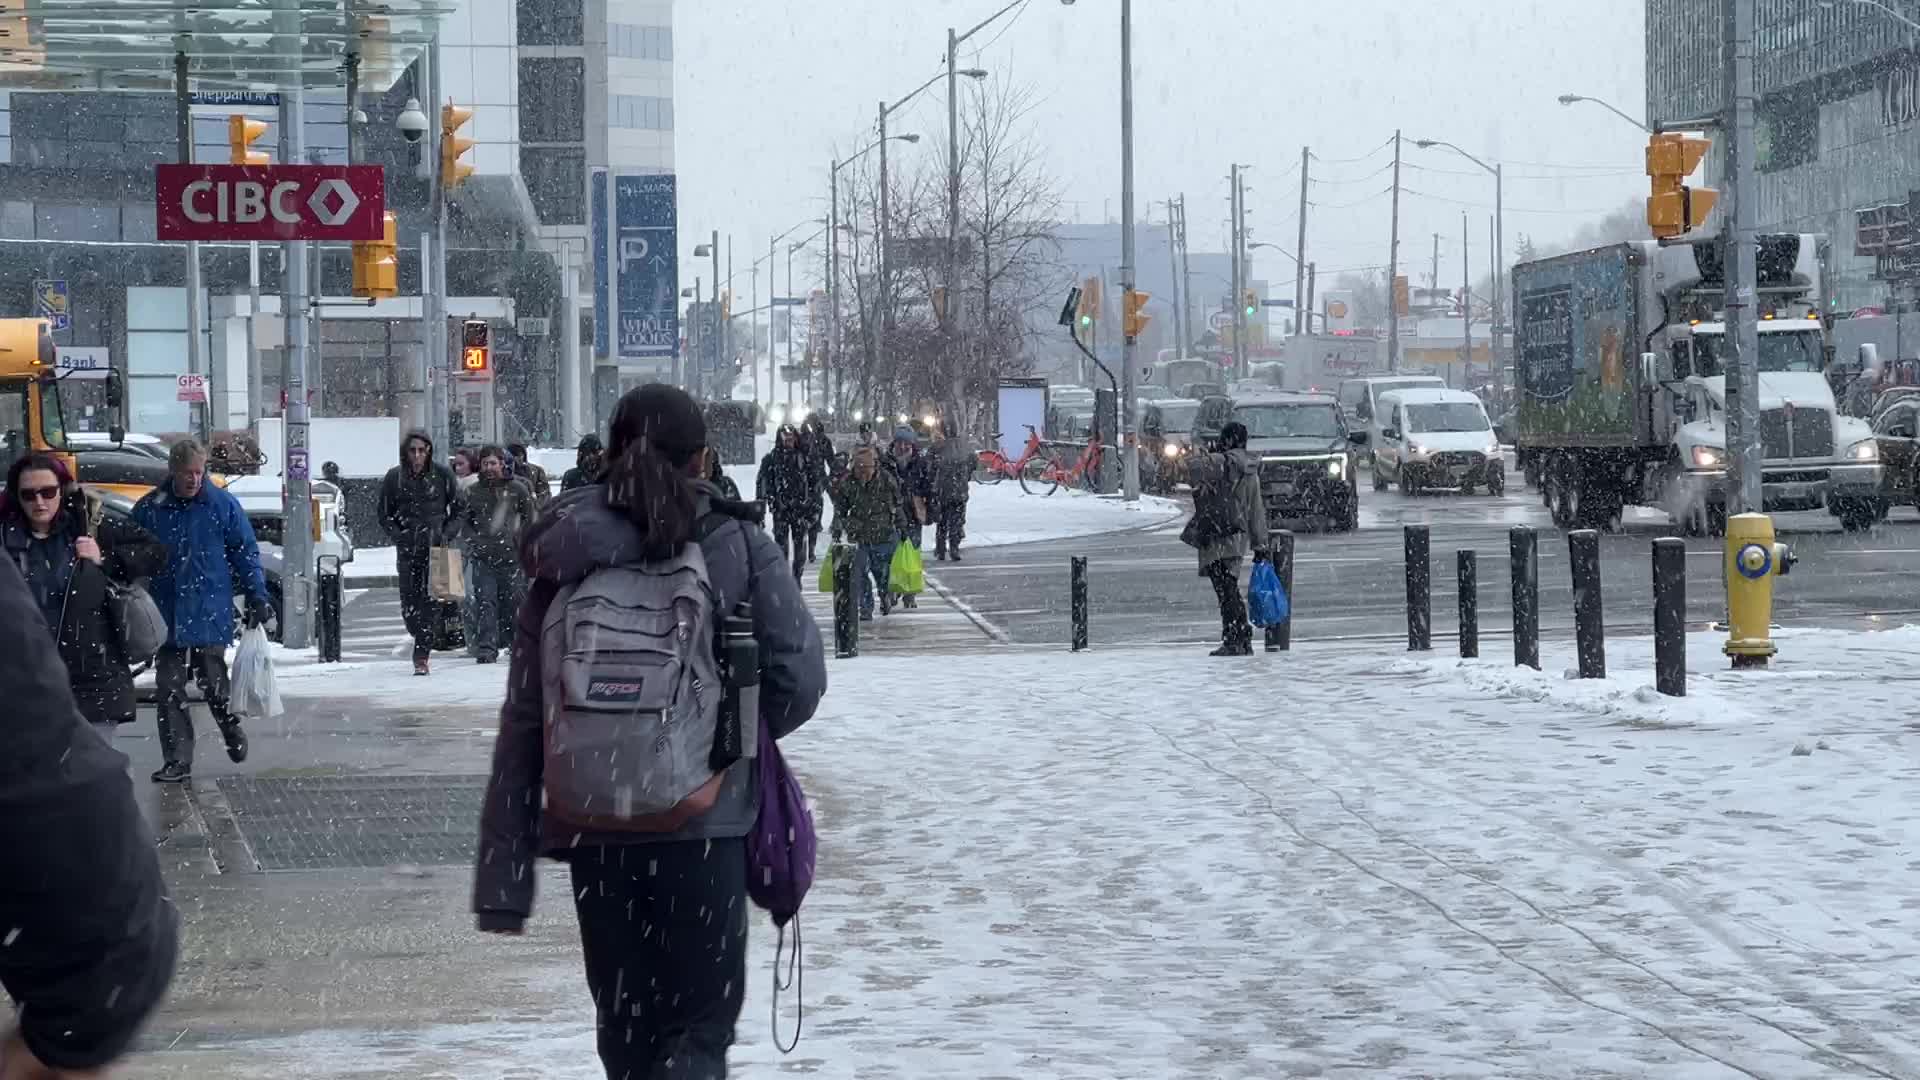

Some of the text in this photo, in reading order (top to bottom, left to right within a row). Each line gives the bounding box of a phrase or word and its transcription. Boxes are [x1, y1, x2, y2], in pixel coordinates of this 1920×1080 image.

[182, 181, 301, 223] CIBC
[620, 237, 648, 274] P
[622, 315, 672, 331] WHOLE
[620, 332, 673, 345] FOODS
[62, 356, 96, 368] Bank
[467, 350, 482, 367] 20
[179, 376, 202, 386] GPS
